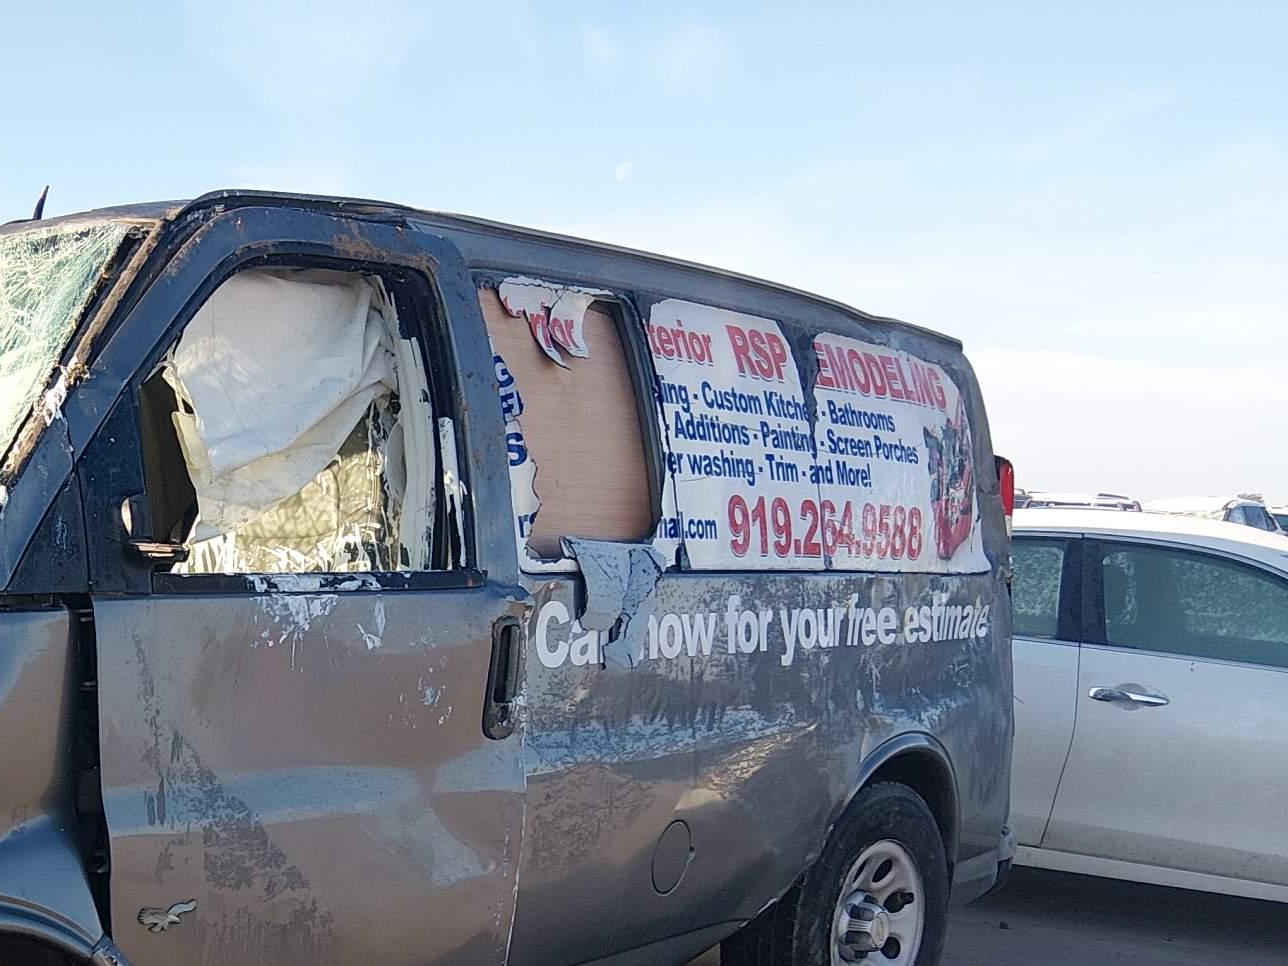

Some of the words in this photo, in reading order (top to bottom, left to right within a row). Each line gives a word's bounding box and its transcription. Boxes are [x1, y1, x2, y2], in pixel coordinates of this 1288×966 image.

[725, 325, 787, 383] RSP
[701, 381, 762, 415] Custom
[827, 400, 896, 432] Bathrooms
[674, 410, 750, 445] Additions
[760, 421, 817, 460] Painting
[827, 429, 873, 458] Screen
[874, 435, 919, 465] Porches
[687, 450, 756, 486] washing
[765, 454, 799, 482] Trim
[809, 459, 833, 485] and
[836, 460, 872, 487] More!
[727, 494, 922, 560] 919.264.9588
[725, 595, 773, 654] for
[780, 606, 846, 667] your
[843, 592, 897, 646] free
[903, 594, 990, 644] estimate
